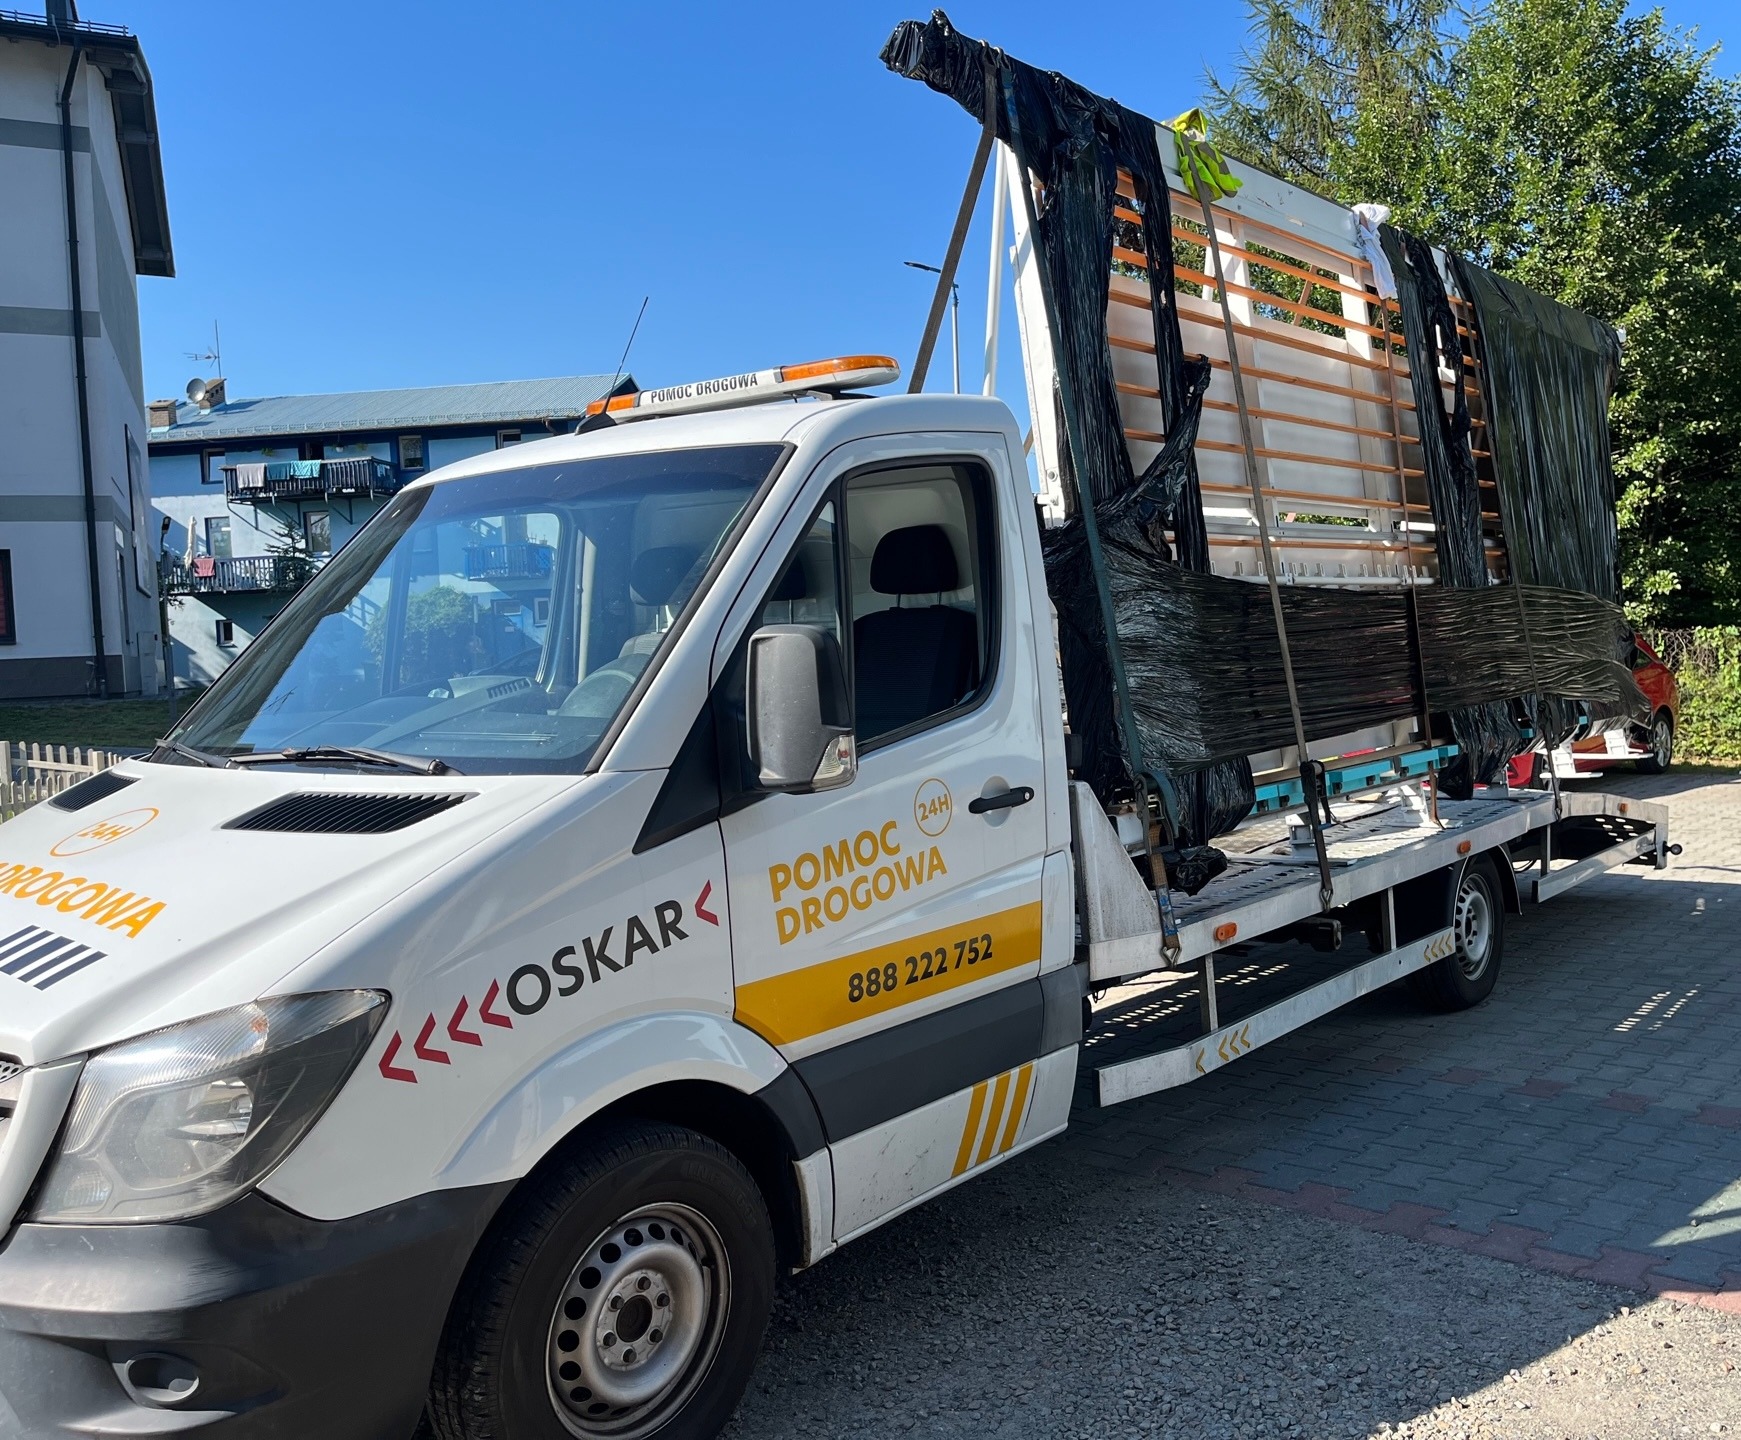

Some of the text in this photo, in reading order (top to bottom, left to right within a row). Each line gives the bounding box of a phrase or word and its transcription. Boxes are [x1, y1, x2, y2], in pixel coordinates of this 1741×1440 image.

[650, 373, 758, 403] POMOC DROGOWA
[917, 793, 949, 822] 24H
[768, 820, 900, 903] POMOC
[775, 846, 947, 945] DROGOWA
[506, 899, 689, 1015] OSKAR
[848, 934, 993, 1003] 888 222 752
